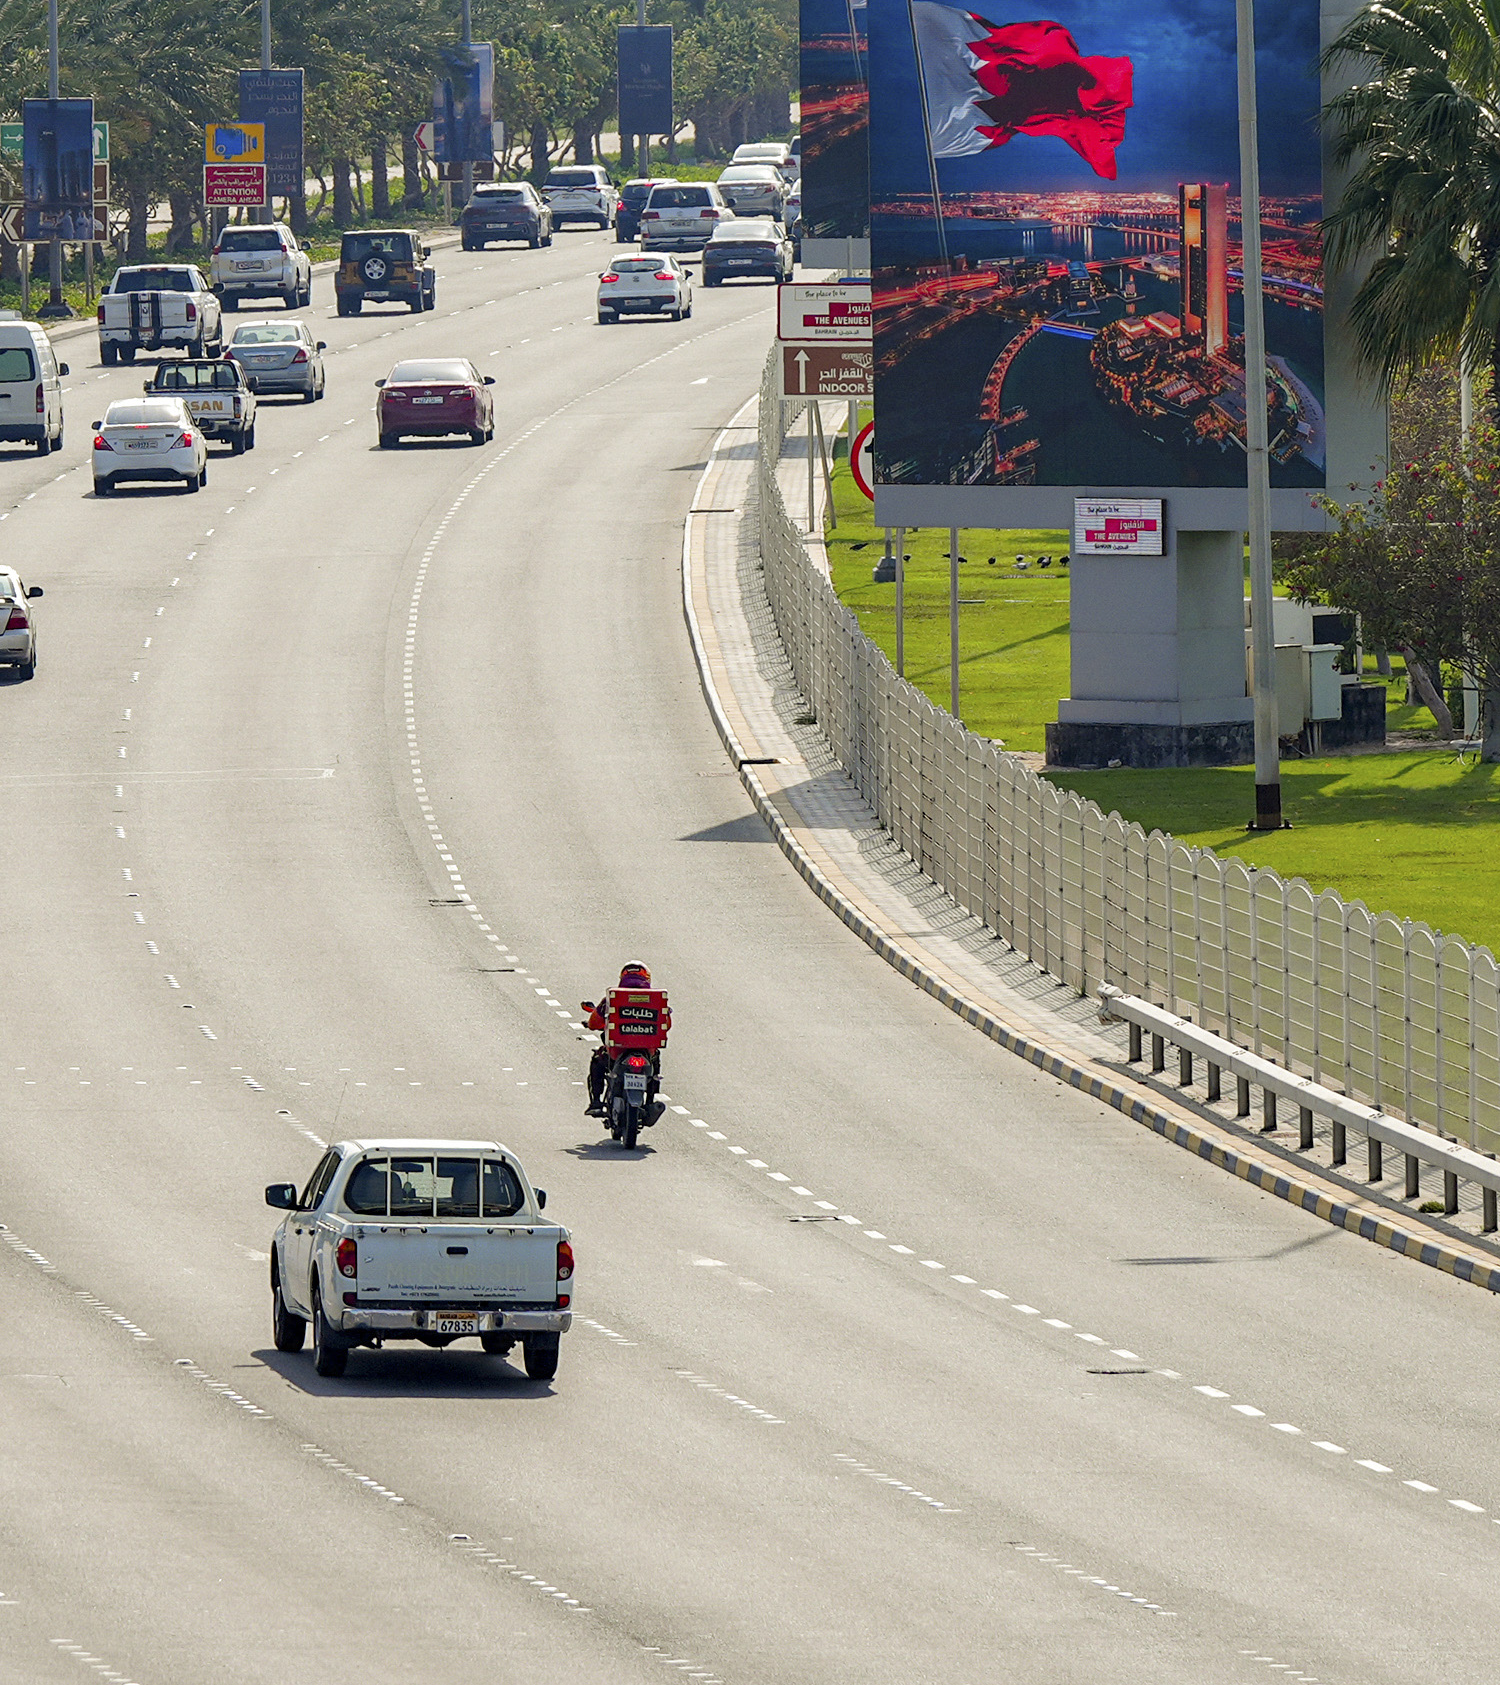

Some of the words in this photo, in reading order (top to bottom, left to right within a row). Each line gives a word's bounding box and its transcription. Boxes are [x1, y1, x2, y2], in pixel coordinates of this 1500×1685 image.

[816, 291, 831, 300] place
[833, 316, 869, 324] AVENUES
[819, 368, 836, 380] الحر
[839, 368, 863, 381] للقفز
[819, 384, 864, 392] INDOOR
[622, 1008, 654, 1019] طلبات
[621, 1024, 654, 1033] talabat
[441, 1321, 474, 1332] 67835
